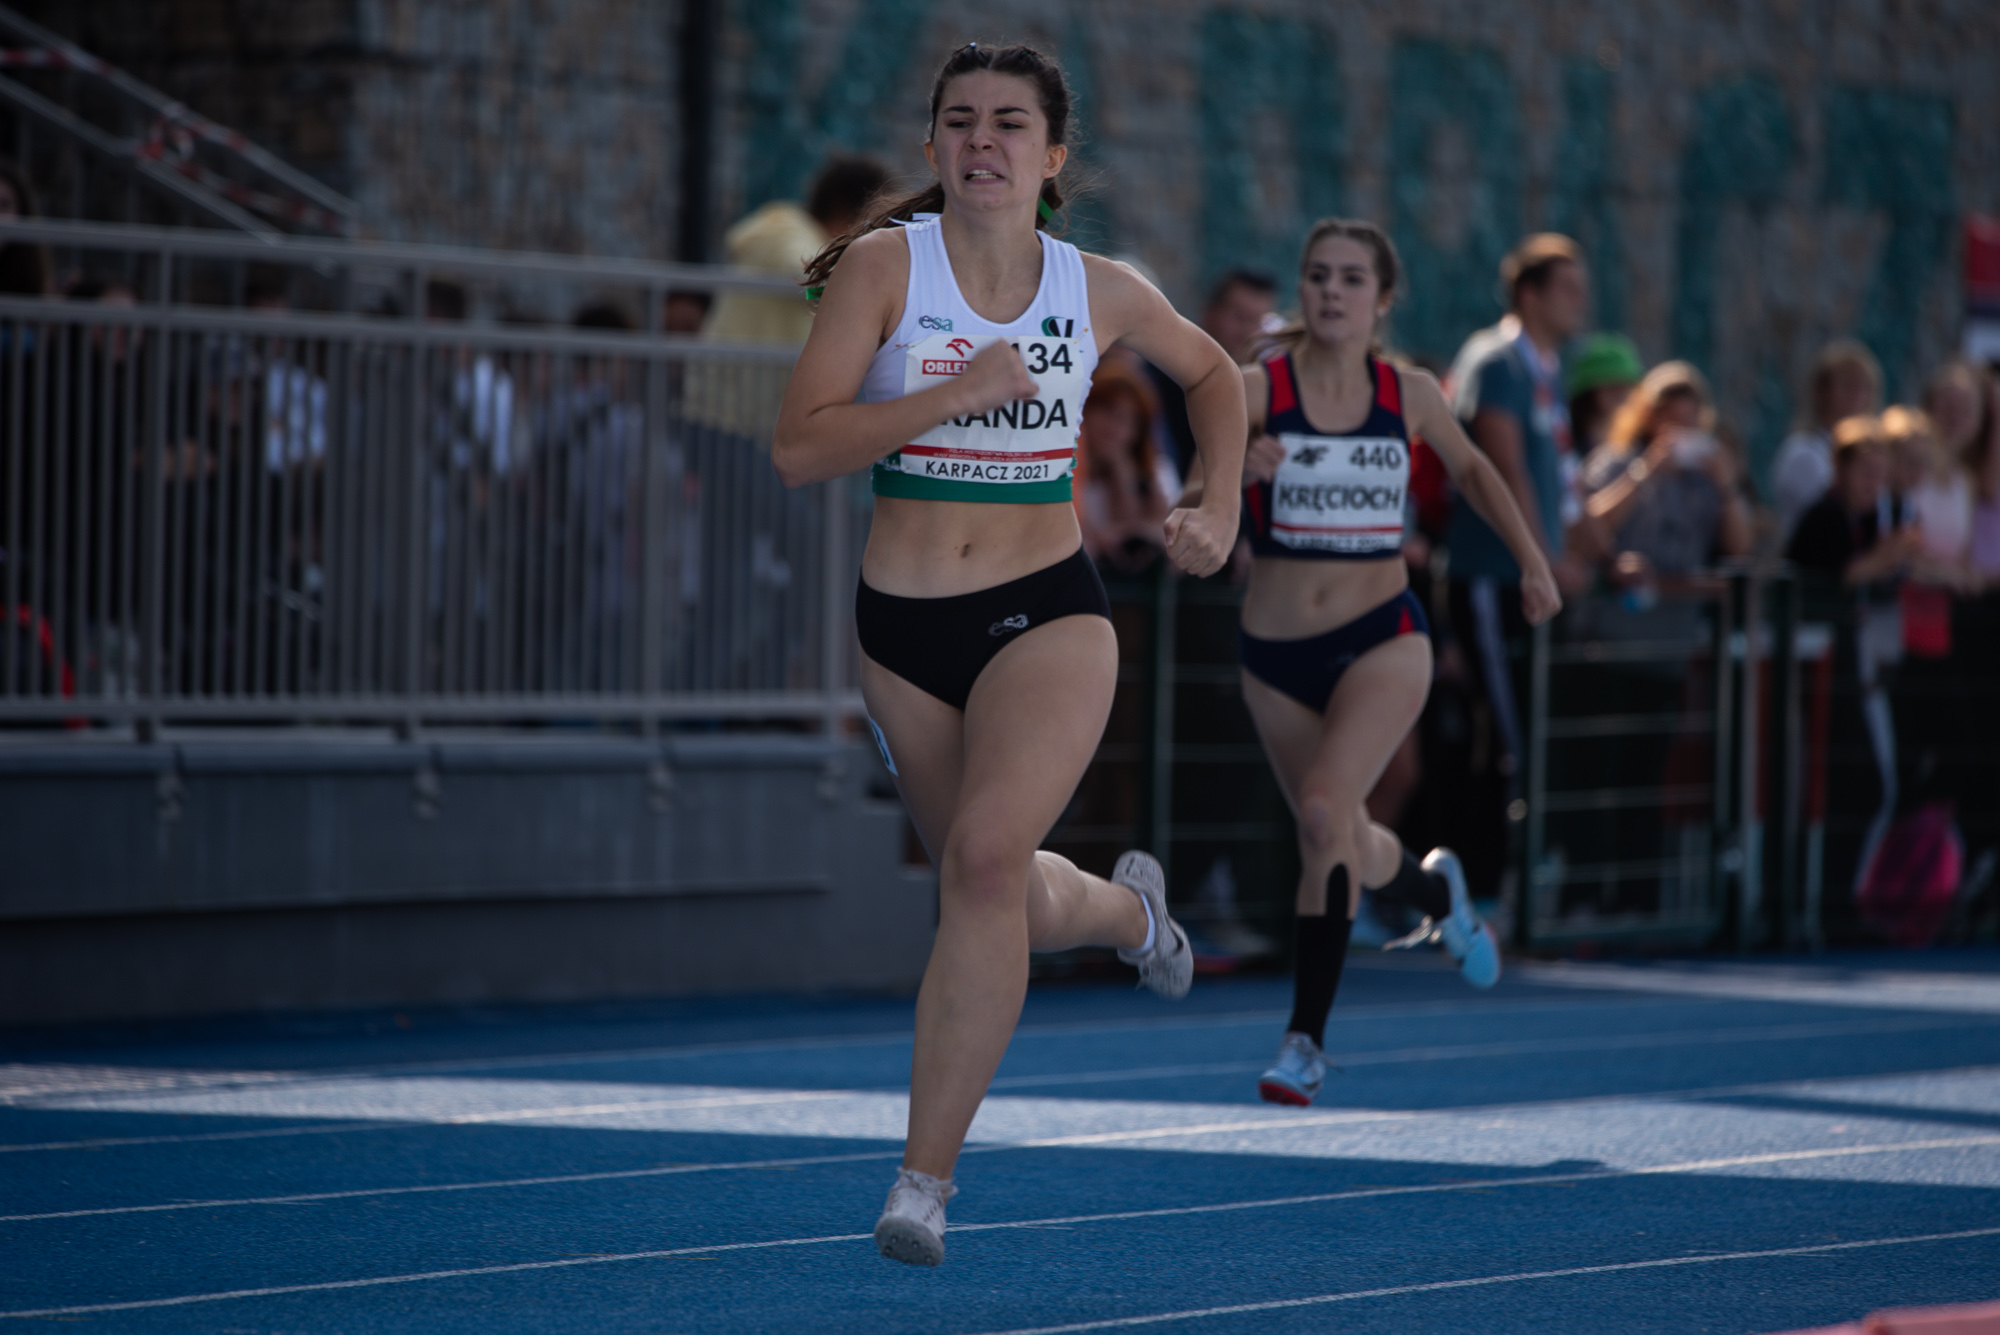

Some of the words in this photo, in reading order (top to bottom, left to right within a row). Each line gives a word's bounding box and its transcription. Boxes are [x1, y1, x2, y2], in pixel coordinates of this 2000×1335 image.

[918, 315, 953, 332] esa
[1010, 342, 1073, 374] 34
[1349, 446, 1401, 468] 440
[925, 460, 1009, 480] KARPACZ
[1013, 464, 1049, 480] 2021
[1277, 484, 1402, 515] KRĘCIOCH
